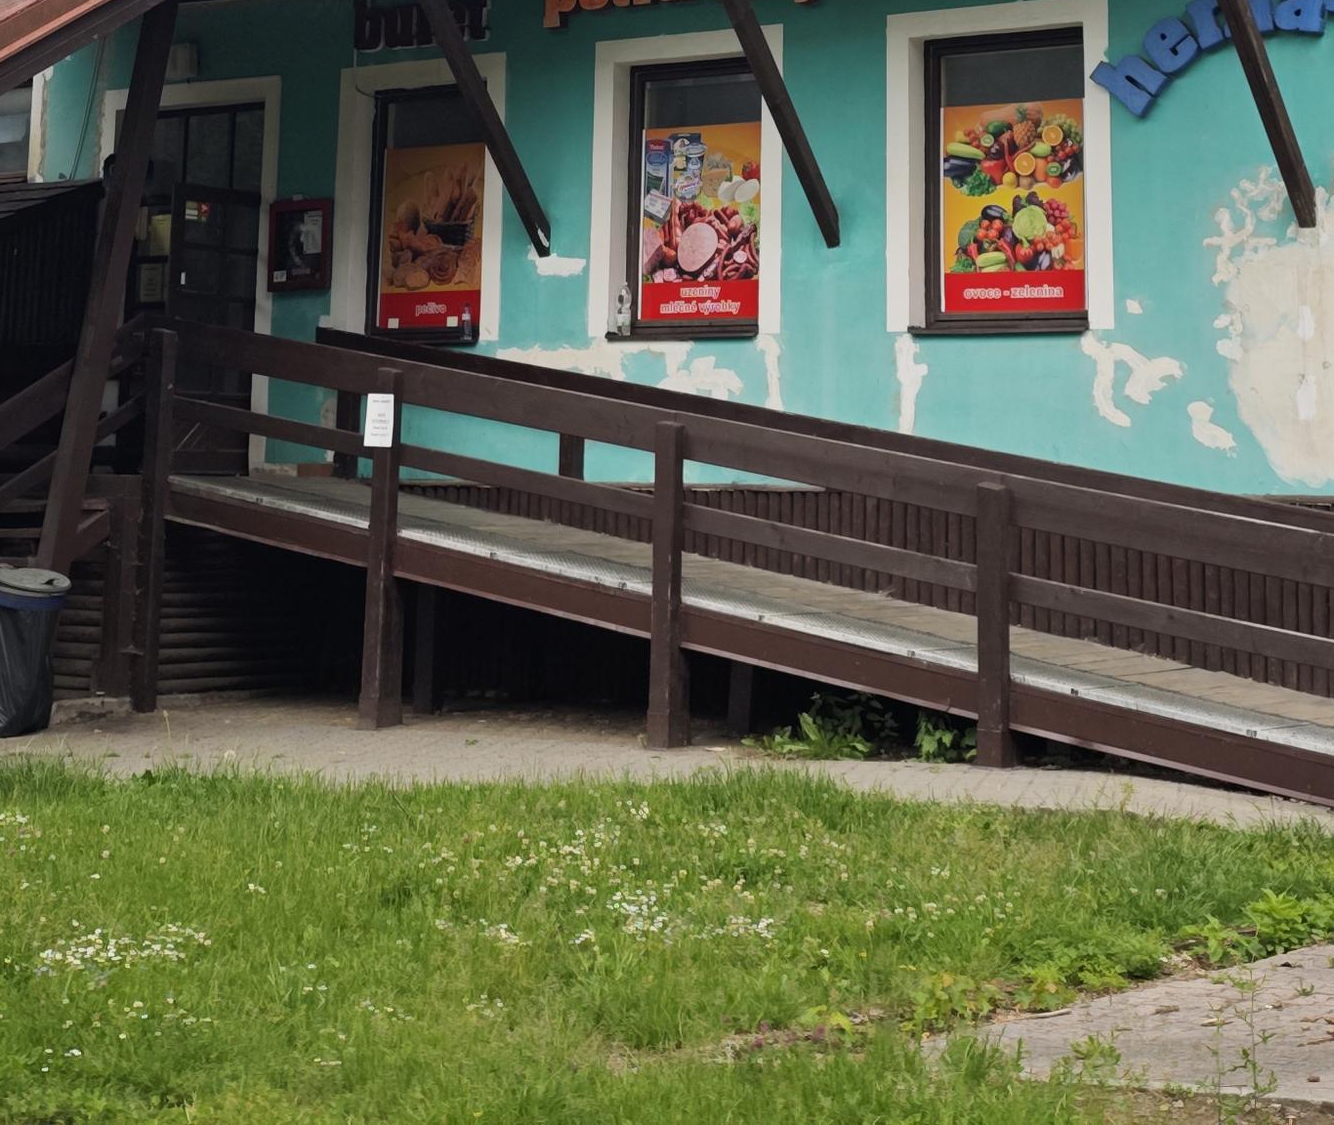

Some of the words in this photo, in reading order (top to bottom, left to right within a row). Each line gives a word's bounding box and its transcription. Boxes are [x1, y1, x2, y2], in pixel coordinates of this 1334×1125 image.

[679, 284, 722, 299] uzeniny
[963, 287, 1002, 300] ovoce
[1010, 284, 1065, 299] zelenina
[415, 301, 447, 317] pečivo
[659, 300, 698, 315] mléčné
[698, 299, 742, 316] výrobky
